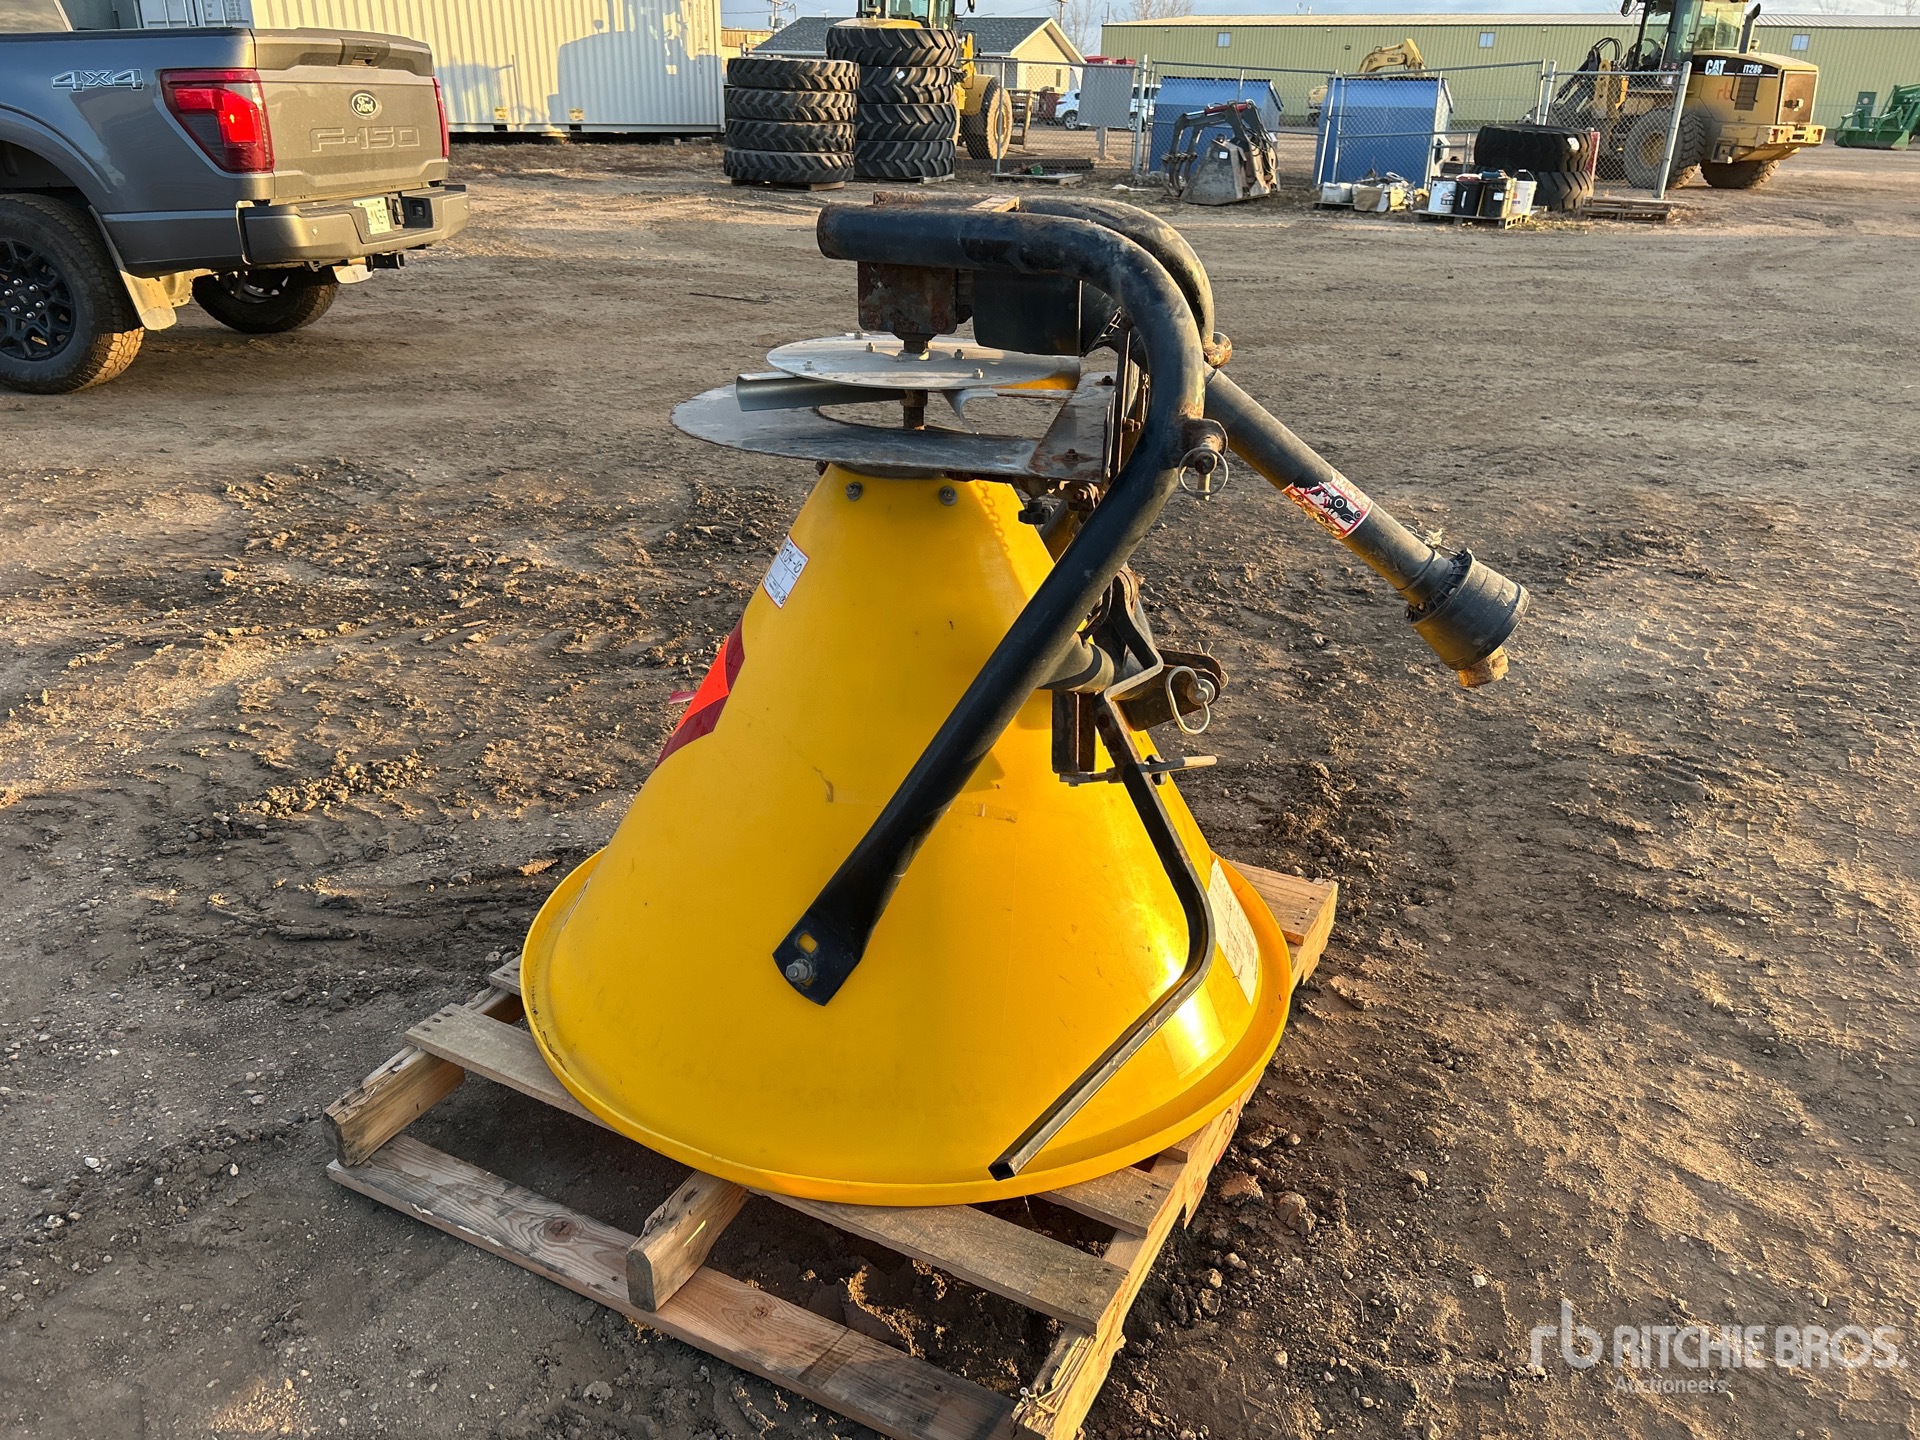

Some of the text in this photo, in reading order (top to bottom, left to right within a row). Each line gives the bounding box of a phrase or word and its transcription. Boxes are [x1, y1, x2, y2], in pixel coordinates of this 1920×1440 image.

[1704, 59, 1727, 76] CAT
[356, 96, 374, 112] Ford
[310, 125, 420, 152] F-150
